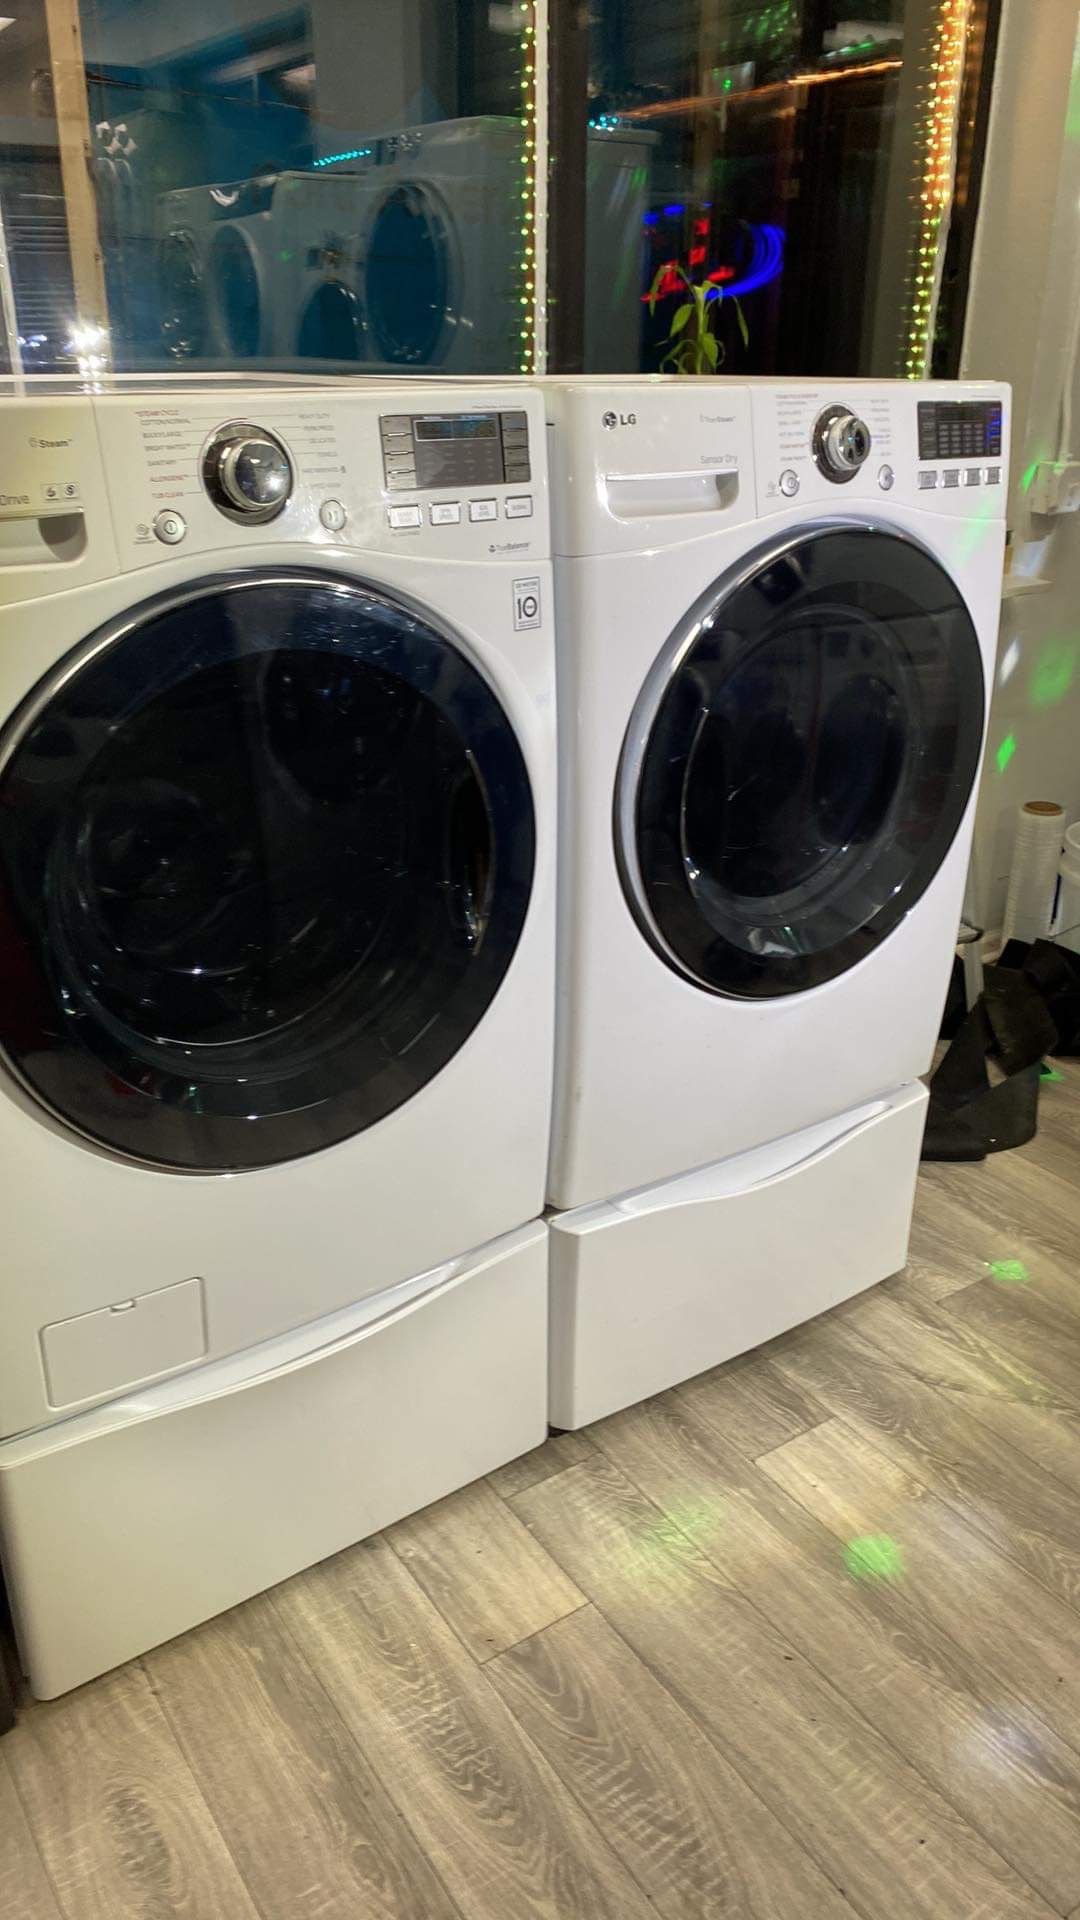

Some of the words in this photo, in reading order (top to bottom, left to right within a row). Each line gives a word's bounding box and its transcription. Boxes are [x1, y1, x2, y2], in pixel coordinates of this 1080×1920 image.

[619, 413, 637, 425] LG
[700, 456, 723, 464] Sensor
[725, 454, 738, 464] Dry
